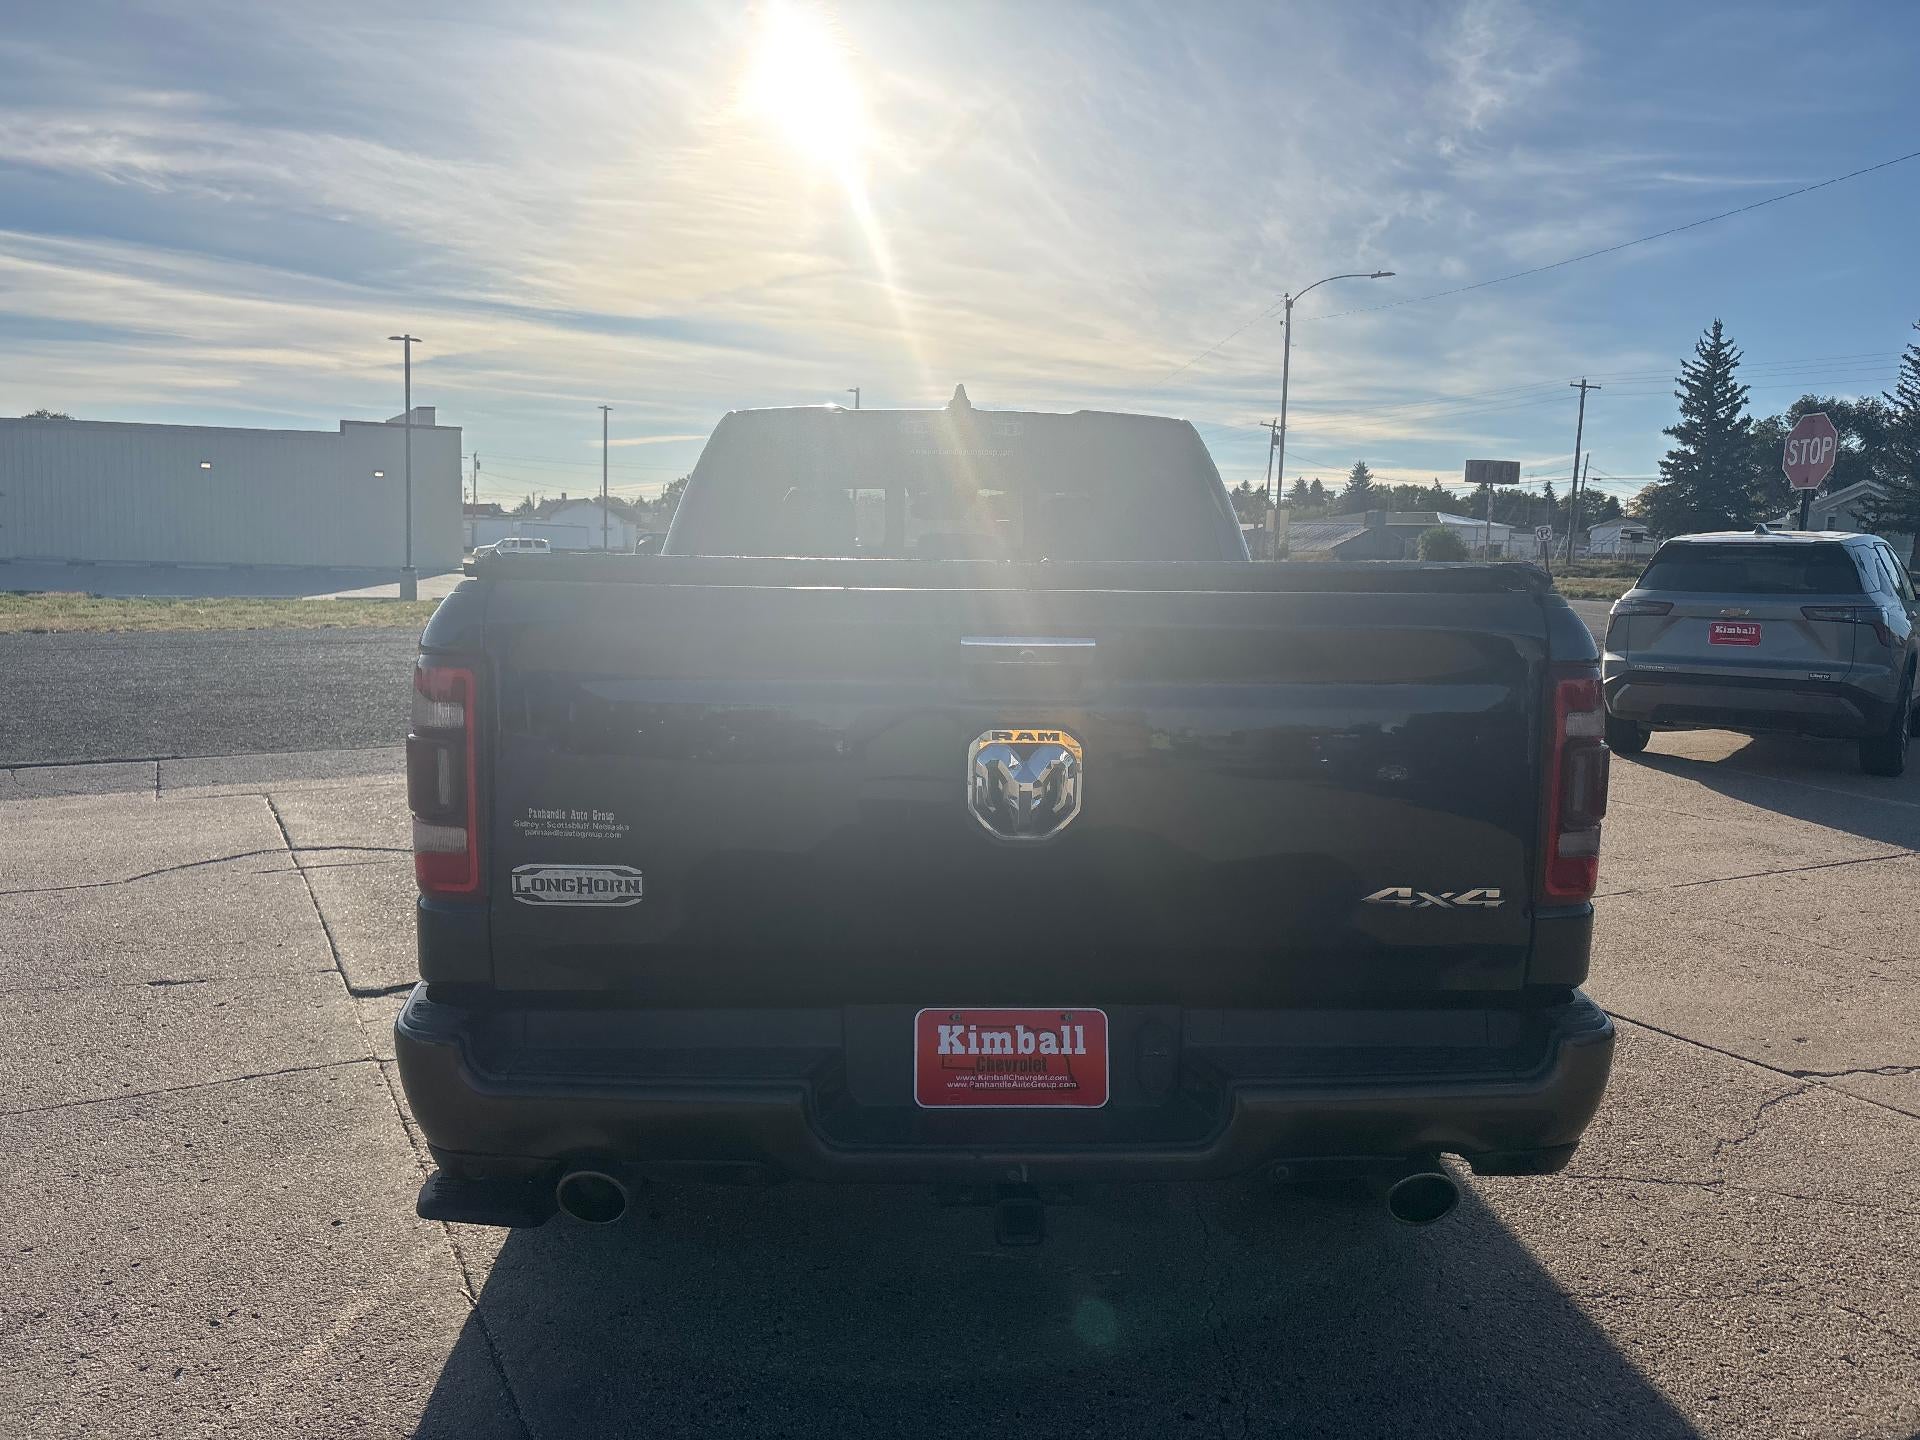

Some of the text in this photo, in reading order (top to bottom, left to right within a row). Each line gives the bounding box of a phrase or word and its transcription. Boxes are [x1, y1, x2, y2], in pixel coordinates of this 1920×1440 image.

[1787, 436, 1833, 466] STOP
[1714, 625, 1756, 635] Kimball
[991, 731, 1060, 742] RAM
[528, 807, 615, 823] Panhandle Auto Group
[937, 1024, 1087, 1055] Kimball
[976, 1056, 1048, 1072] Chevrolet
